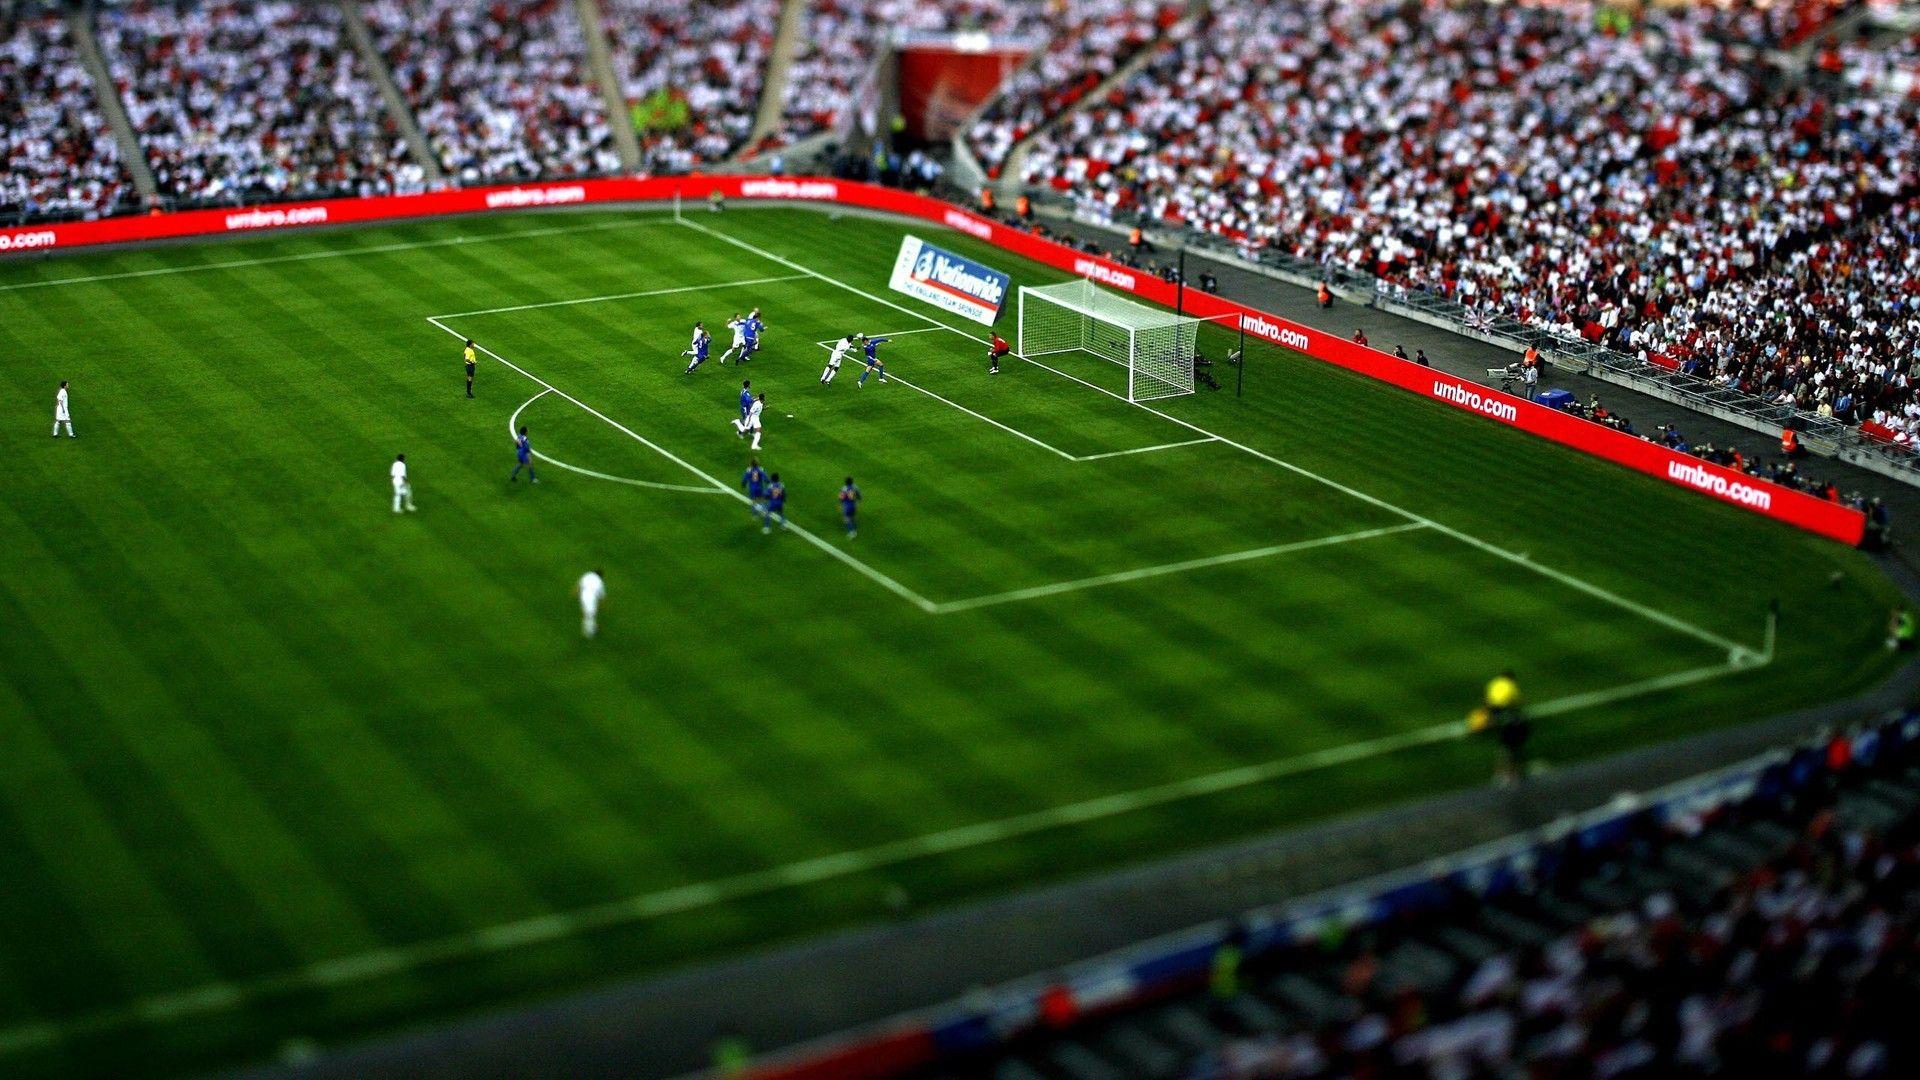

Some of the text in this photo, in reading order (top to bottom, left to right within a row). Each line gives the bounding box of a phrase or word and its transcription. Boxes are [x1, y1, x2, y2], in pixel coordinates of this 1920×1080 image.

[226, 207, 327, 229] umbro.com
[931, 255, 1002, 303] Nationwide
[1433, 380, 1517, 421] umbro.com
[1668, 460, 1771, 510] umbro.com
